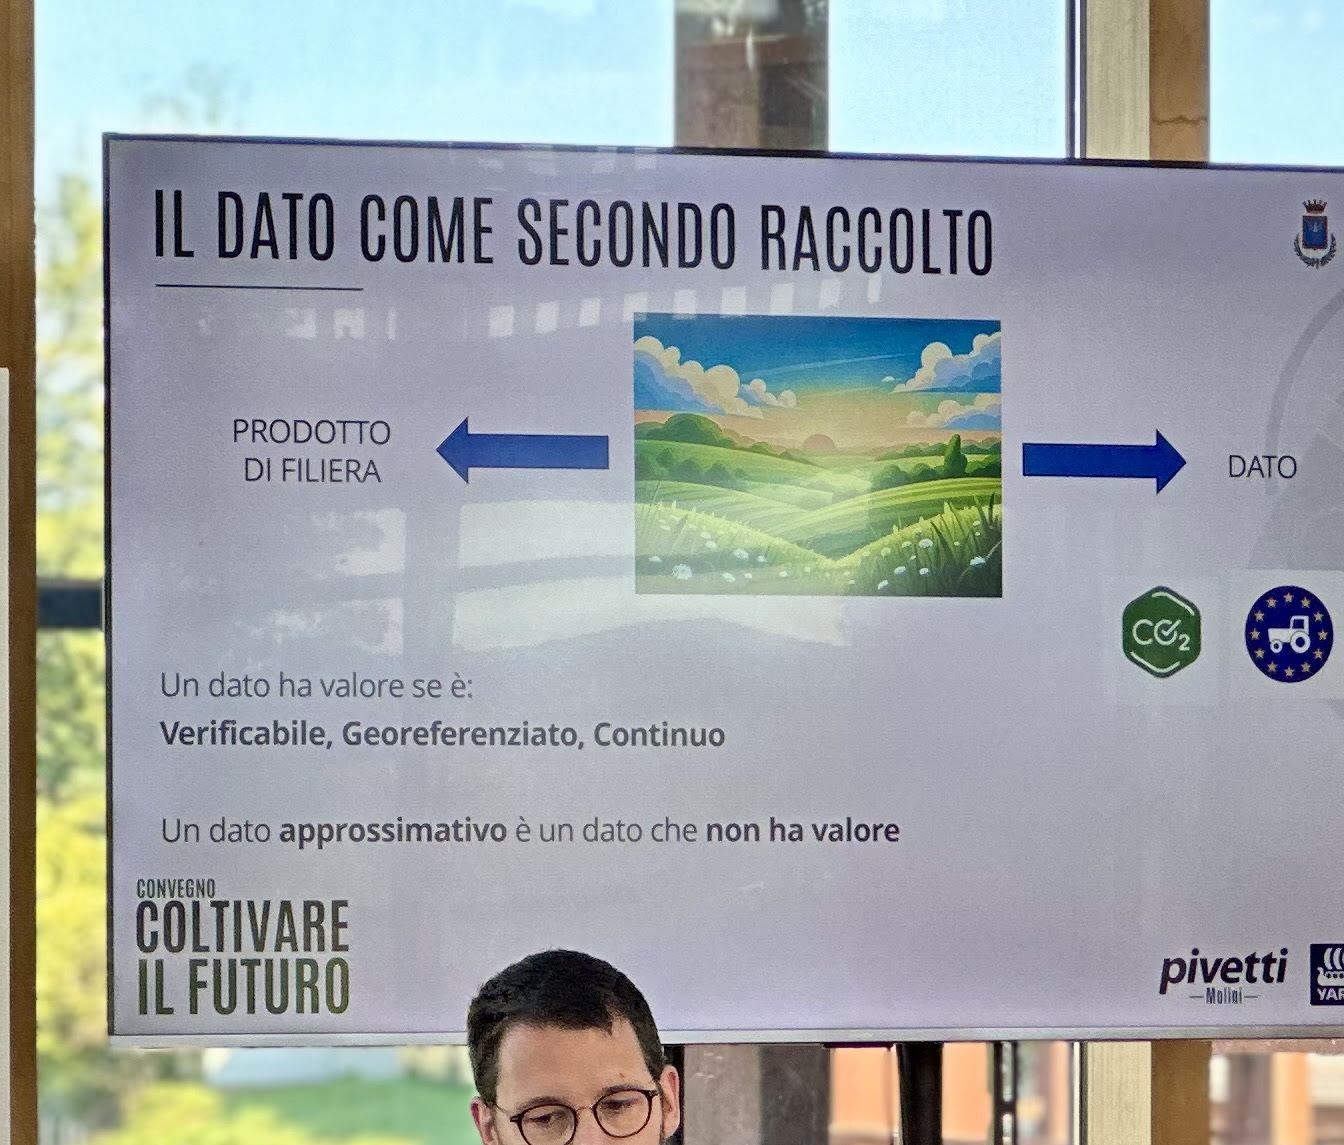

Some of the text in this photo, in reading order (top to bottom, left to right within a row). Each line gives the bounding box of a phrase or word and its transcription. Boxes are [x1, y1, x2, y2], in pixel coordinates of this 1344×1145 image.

[155, 190, 992, 276] IL DATO COME SECONDO RACCOLTO
[234, 419, 390, 445] PRODOTTO
[245, 458, 381, 483] DI FILIERA
[1229, 455, 1297, 478] DATO
[162, 671, 472, 698] Un dato ha valore se è:
[160, 720, 725, 750] Verificabile, Georeferenziato, Continuo
[163, 816, 899, 849] Un dato approssimativo è un dato che non ha valore
[137, 879, 215, 898] CONVEGNO
[136, 900, 349, 953] COLTIVARE
[1159, 948, 1288, 994] pivetti
[139, 958, 349, 1015] IL FUTURO
[1206, 987, 1243, 1004] Molini
